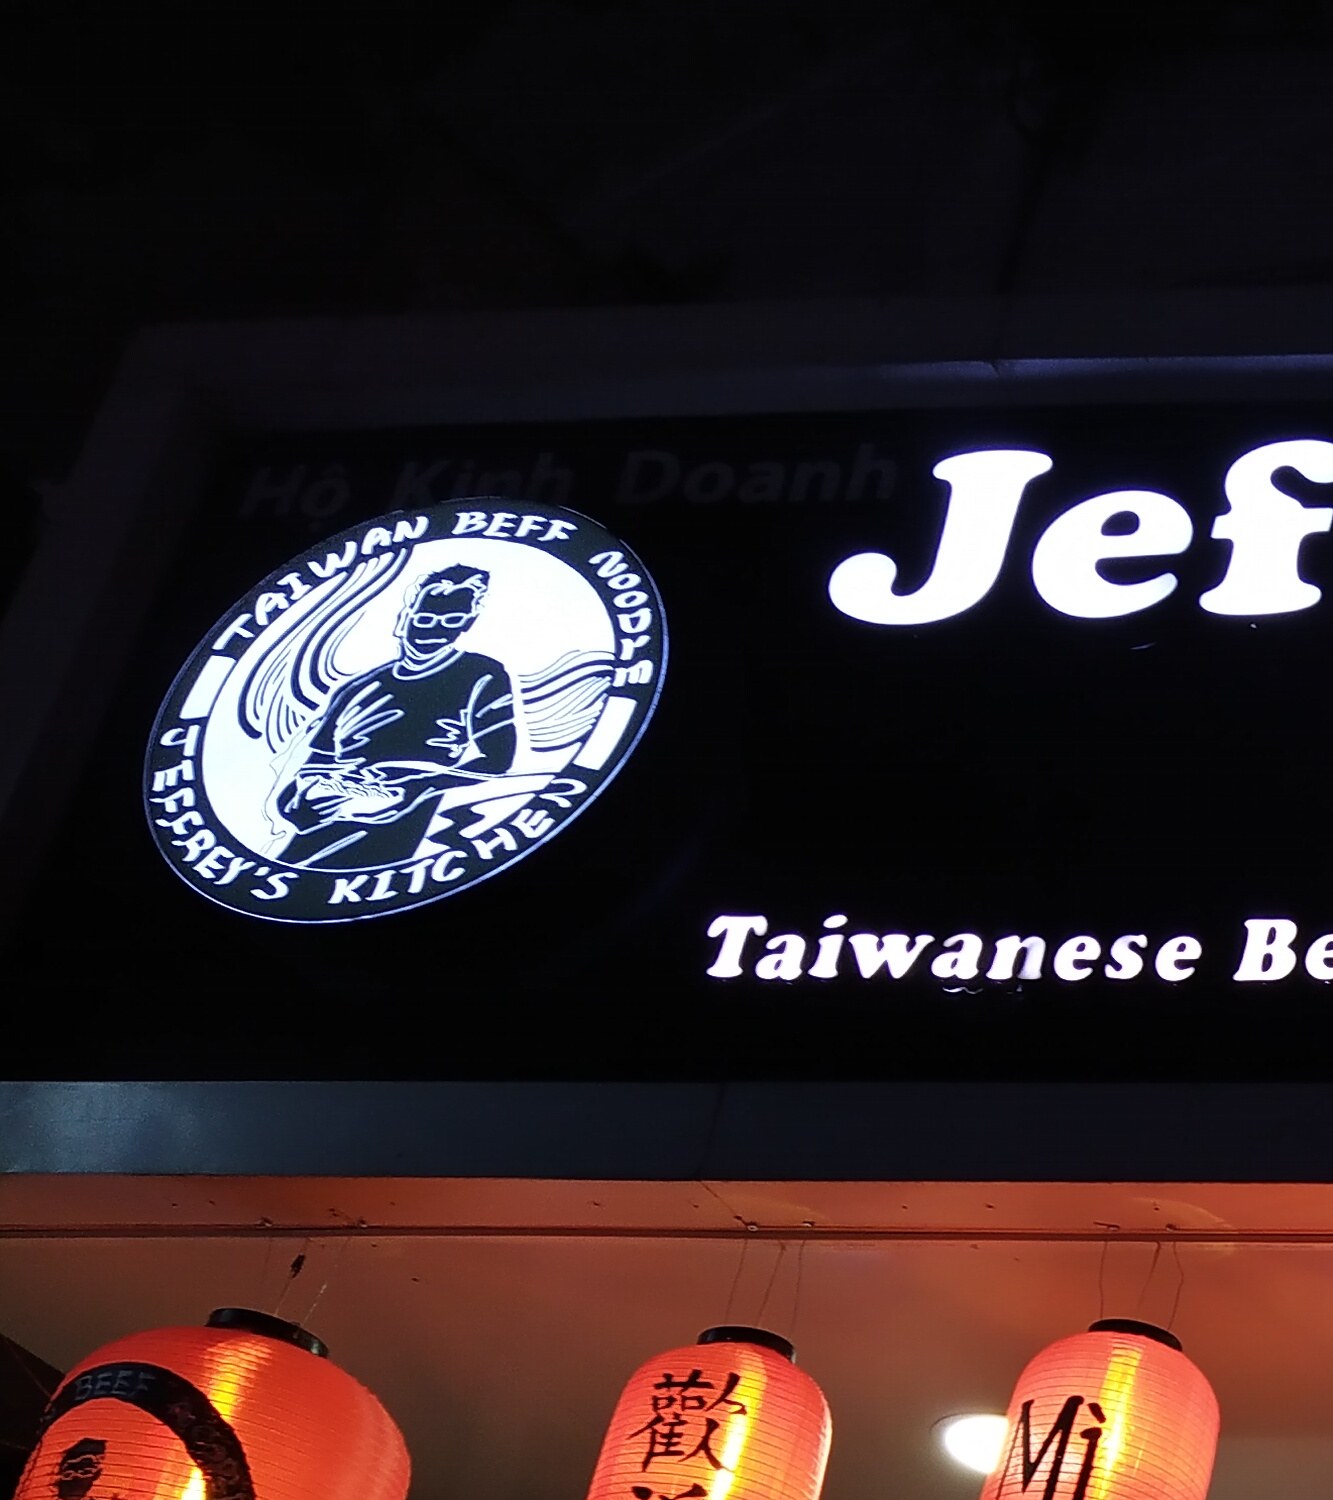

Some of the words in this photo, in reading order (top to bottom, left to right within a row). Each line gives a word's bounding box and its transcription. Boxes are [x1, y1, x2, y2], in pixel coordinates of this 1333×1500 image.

[619, 444, 899, 504] Doanh
[213, 516, 428, 652] TAIWAN
[589, 550, 654, 687] NOODLE
[149, 725, 299, 900] JEFFREY'S
[327, 777, 588, 904] KITCHEN
[707, 913, 1203, 981] Taiwanese
